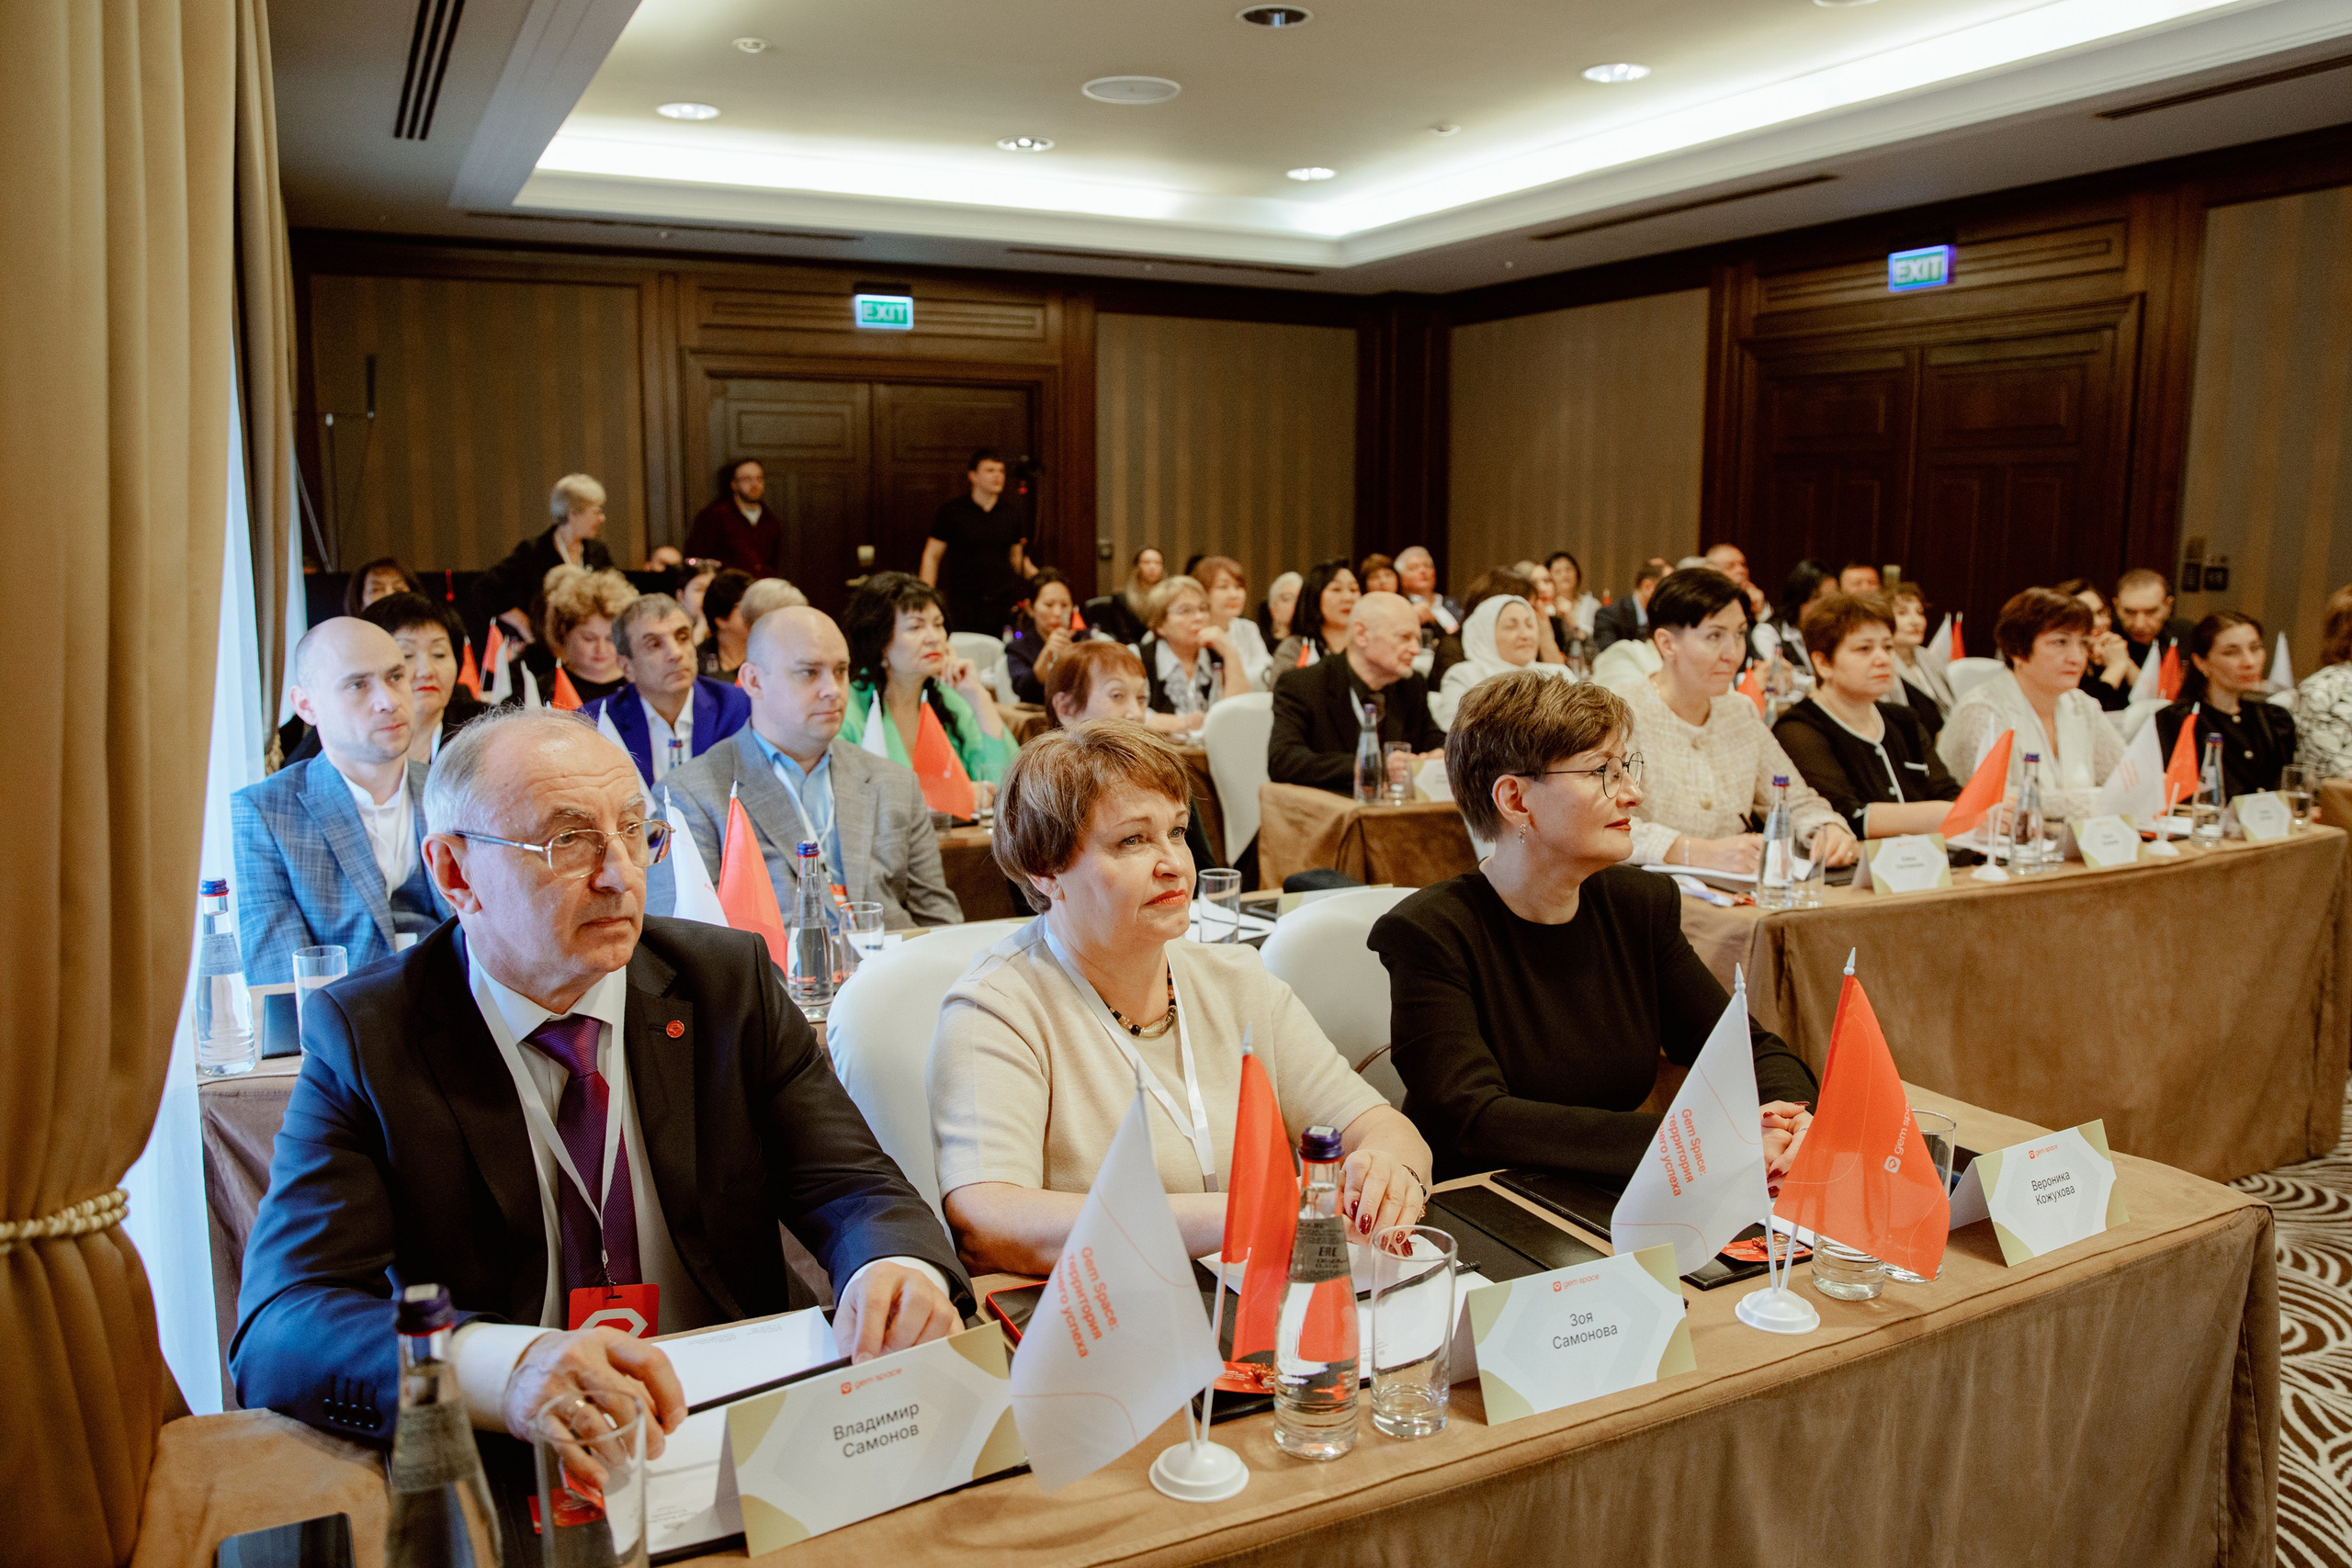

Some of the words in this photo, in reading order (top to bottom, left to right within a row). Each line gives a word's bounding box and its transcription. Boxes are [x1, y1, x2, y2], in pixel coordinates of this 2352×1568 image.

[1894, 255, 1942, 283] EXIT
[862, 302, 906, 321] EXIT
[1681, 1108, 1696, 1137] Gem
[1690, 1137, 1707, 1176] Space:
[1894, 1127, 1908, 1156] gem
[1903, 1101, 1911, 1126] spa
[1668, 1113, 1694, 1183] территория
[1660, 1155, 1682, 1197] успеха
[2030, 1171, 2071, 1191] Вероника
[2035, 1185, 2075, 1206] Кожухова
[1081, 1247, 1100, 1282] Gem
[1068, 1253, 1103, 1340] территория
[1563, 1279, 1578, 1290] gem
[1579, 1274, 1600, 1285] space
[1061, 1306, 1090, 1358] успеха
[1569, 1312, 1594, 1326] Зоя
[1553, 1325, 1618, 1349] Самонова
[854, 1377, 874, 1391] gem
[875, 1368, 902, 1382] space
[833, 1404, 920, 1440] Владимир
[842, 1424, 920, 1458] Самонов
